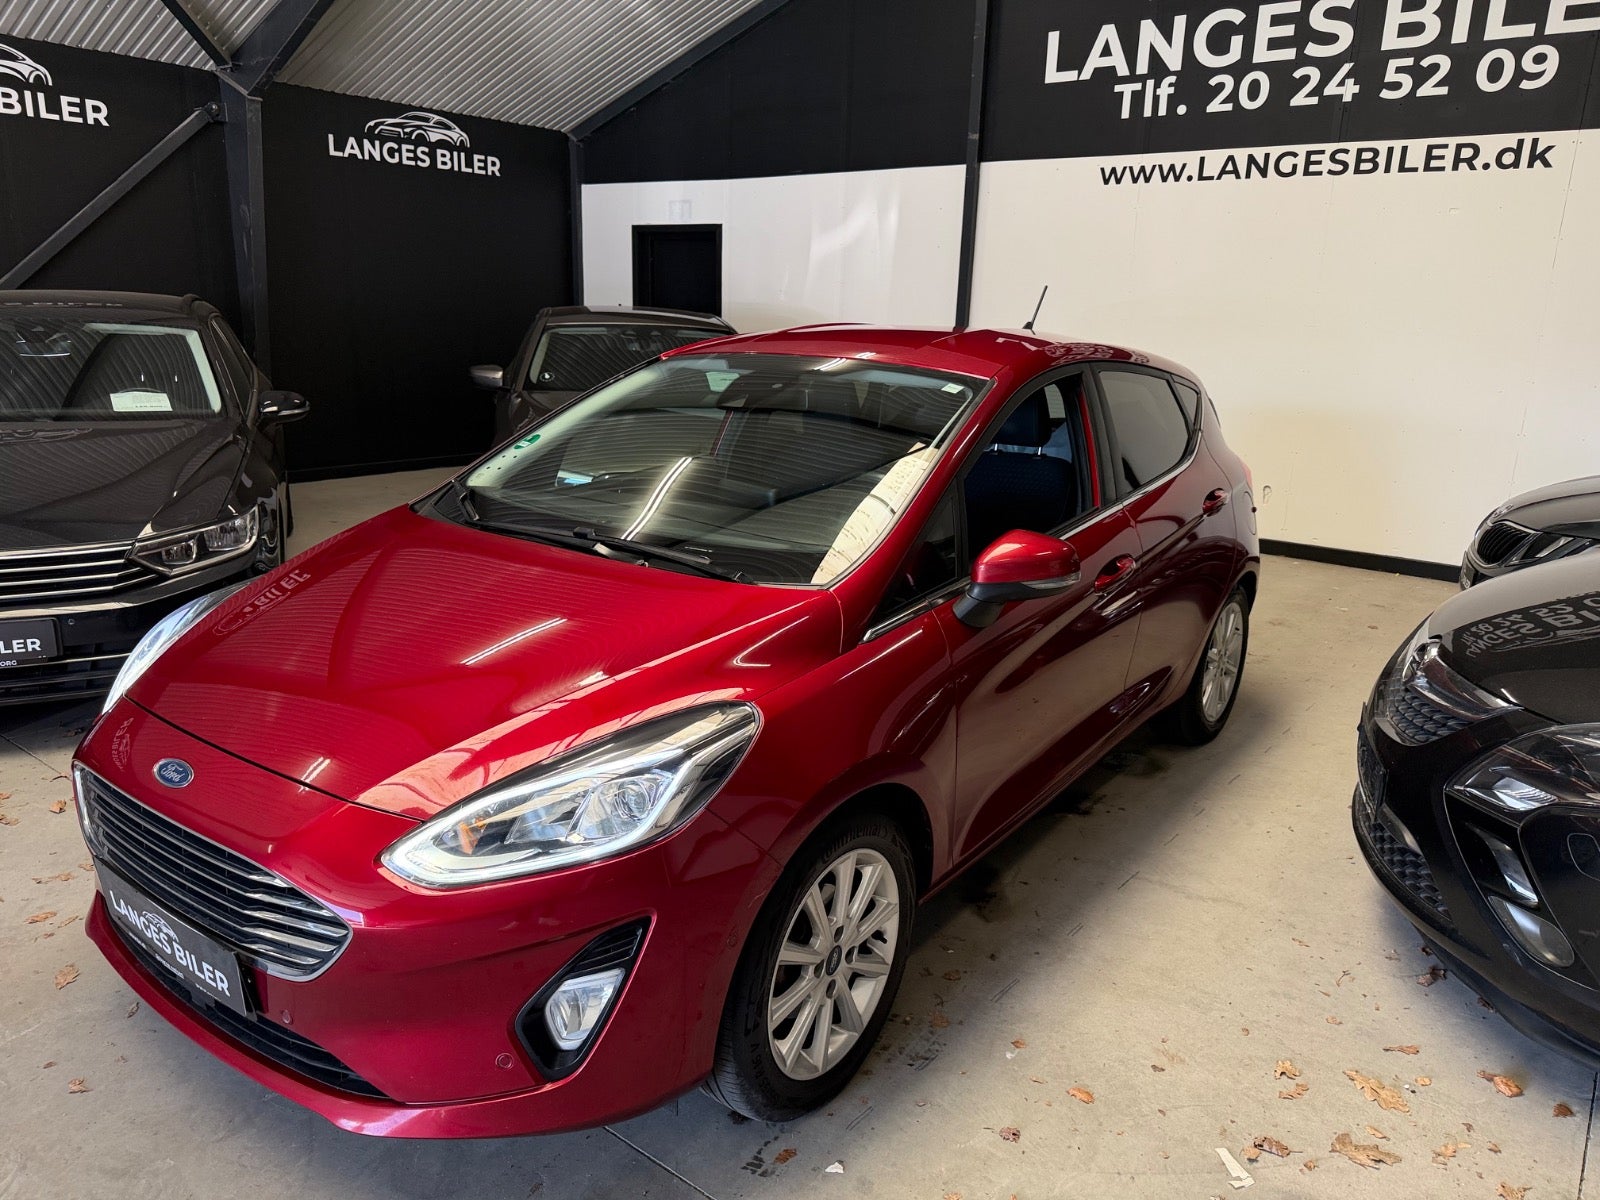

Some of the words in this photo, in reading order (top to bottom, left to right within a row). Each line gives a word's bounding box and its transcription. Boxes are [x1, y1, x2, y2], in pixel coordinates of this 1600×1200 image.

[1044, 0, 1355, 84] LANGES
[1113, 75, 1187, 119] Tlf.
[1206, 70, 1270, 113] 20
[1289, 62, 1360, 107] 24
[1378, 54, 1452, 100] 52
[1475, 44, 1560, 93] 09
[0, 86, 110, 127] BILER
[327, 133, 431, 168] LANGES
[436, 149, 501, 177] BILER
[1100, 137, 1556, 186] www.LANGESBILER.dk
[160, 763, 186, 782] Ford
[109, 890, 172, 955] LANGES
[172, 941, 230, 998] BILER
